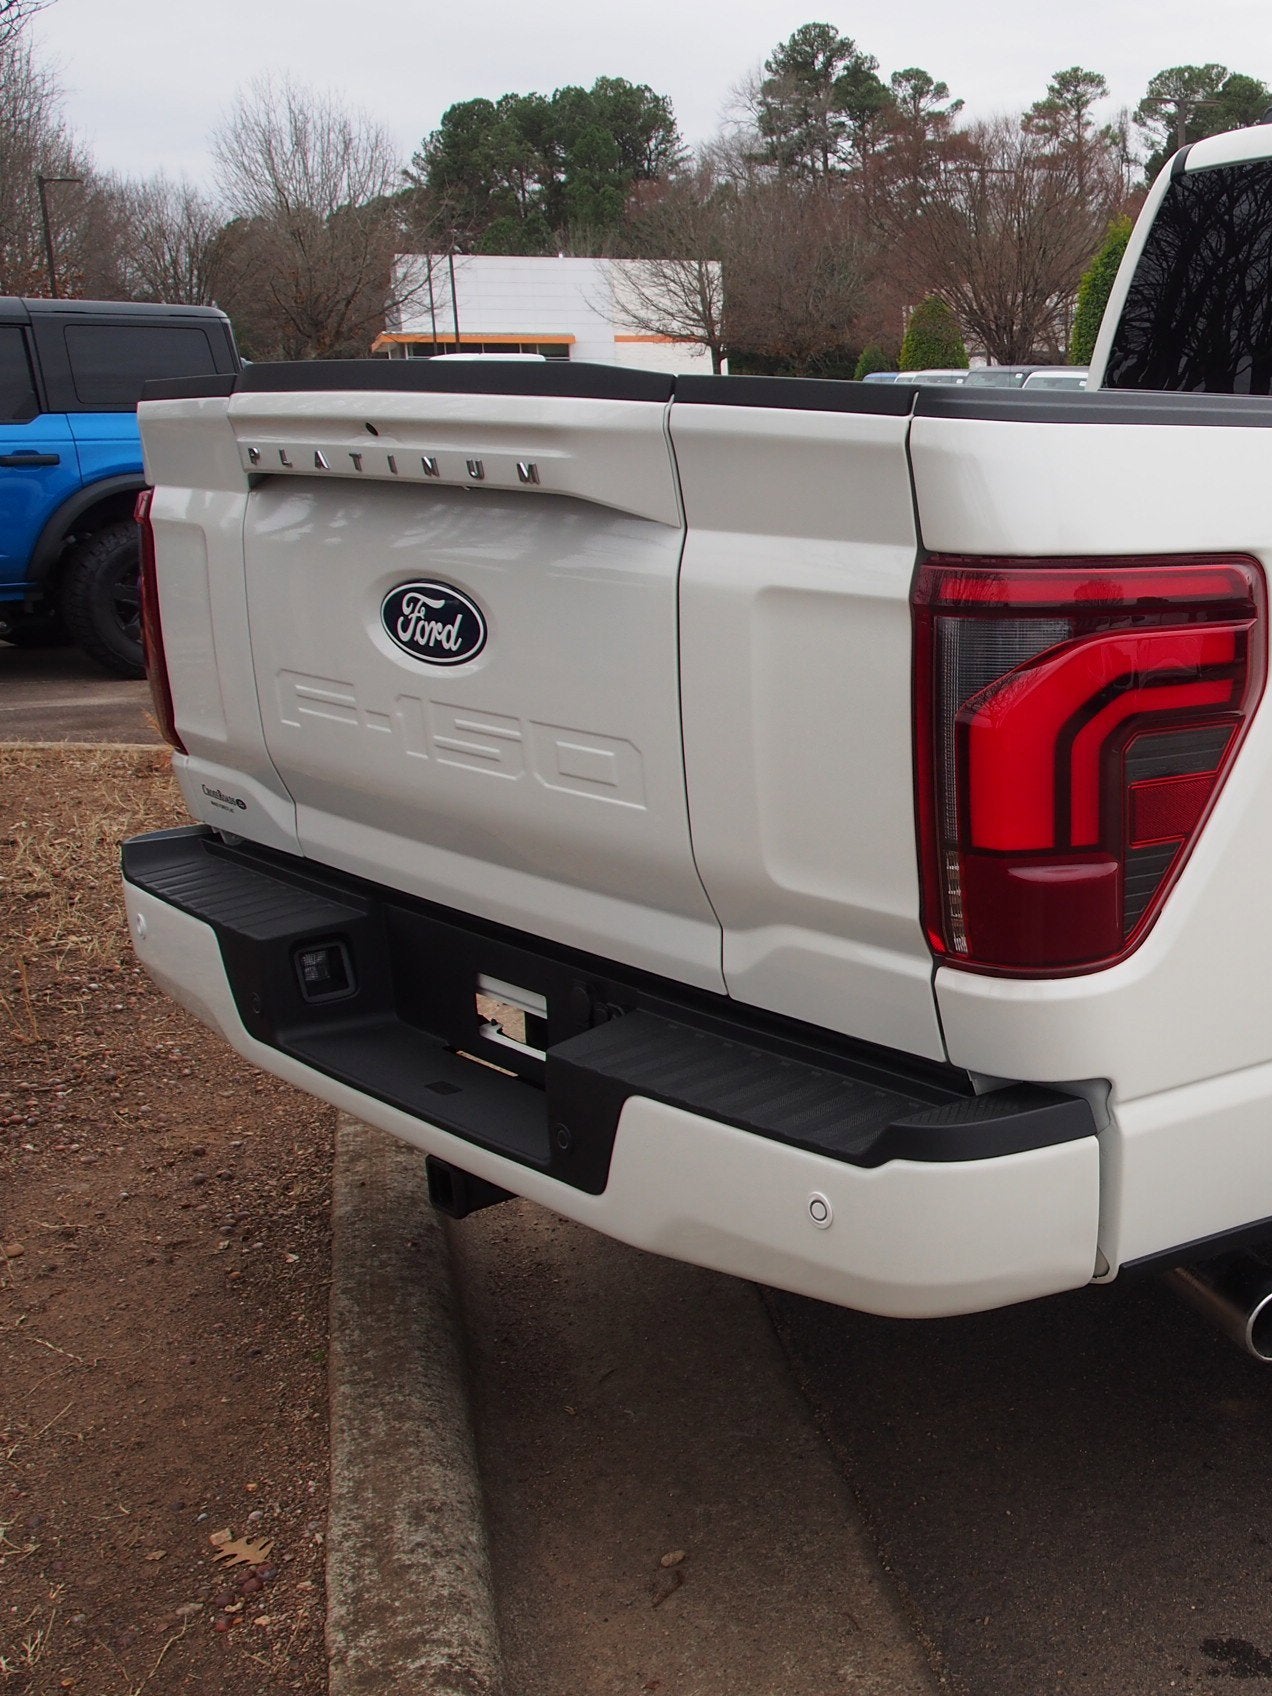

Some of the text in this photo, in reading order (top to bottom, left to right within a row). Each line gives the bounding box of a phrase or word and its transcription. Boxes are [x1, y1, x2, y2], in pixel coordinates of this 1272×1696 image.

[249, 447, 540, 485] PLATINUM
[397, 592, 462, 651] Ford
[276, 668, 647, 811] F-150
